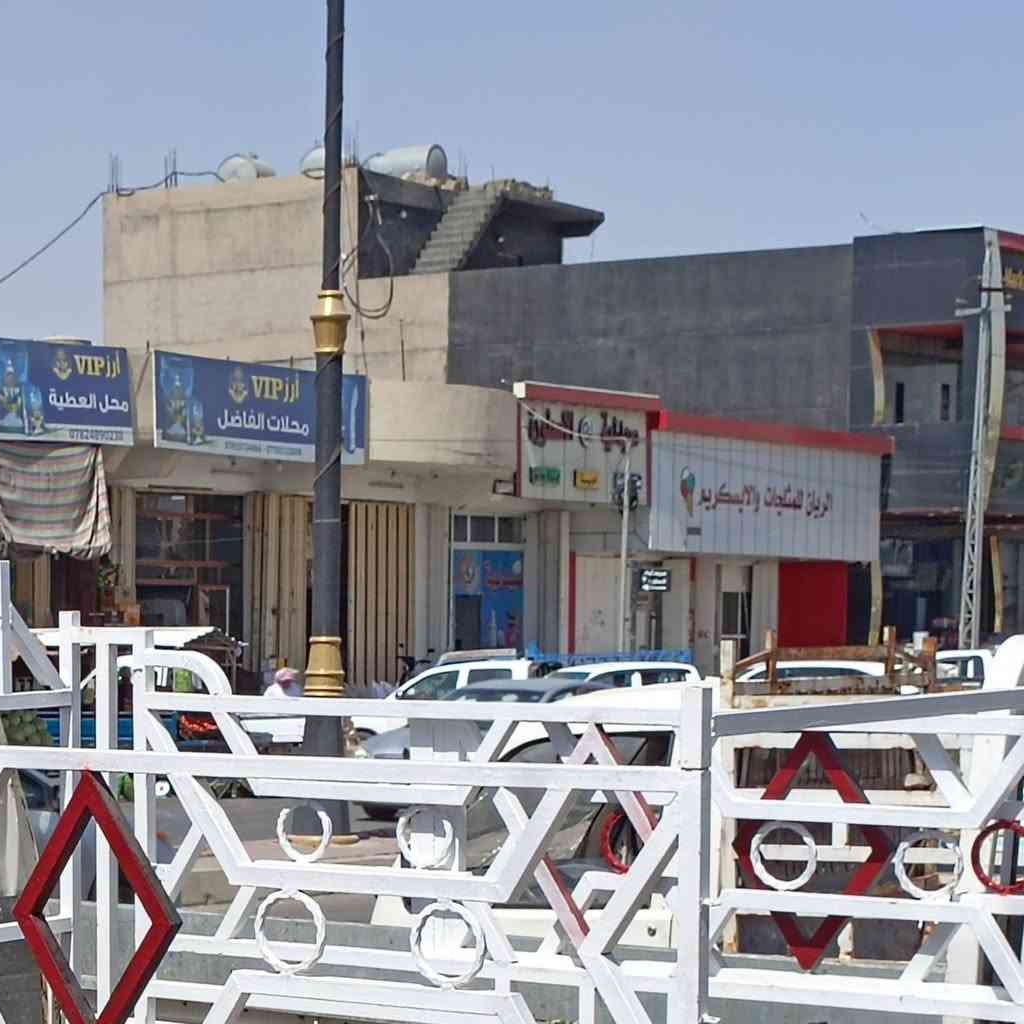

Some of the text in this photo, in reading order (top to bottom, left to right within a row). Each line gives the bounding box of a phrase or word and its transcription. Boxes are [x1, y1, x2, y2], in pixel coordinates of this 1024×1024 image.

[73, 354, 105, 378] VIP
[48, 387, 130, 413] محل العطية
[251, 374, 284, 400] VIP
[217, 408, 310, 437] محلات الفاضل
